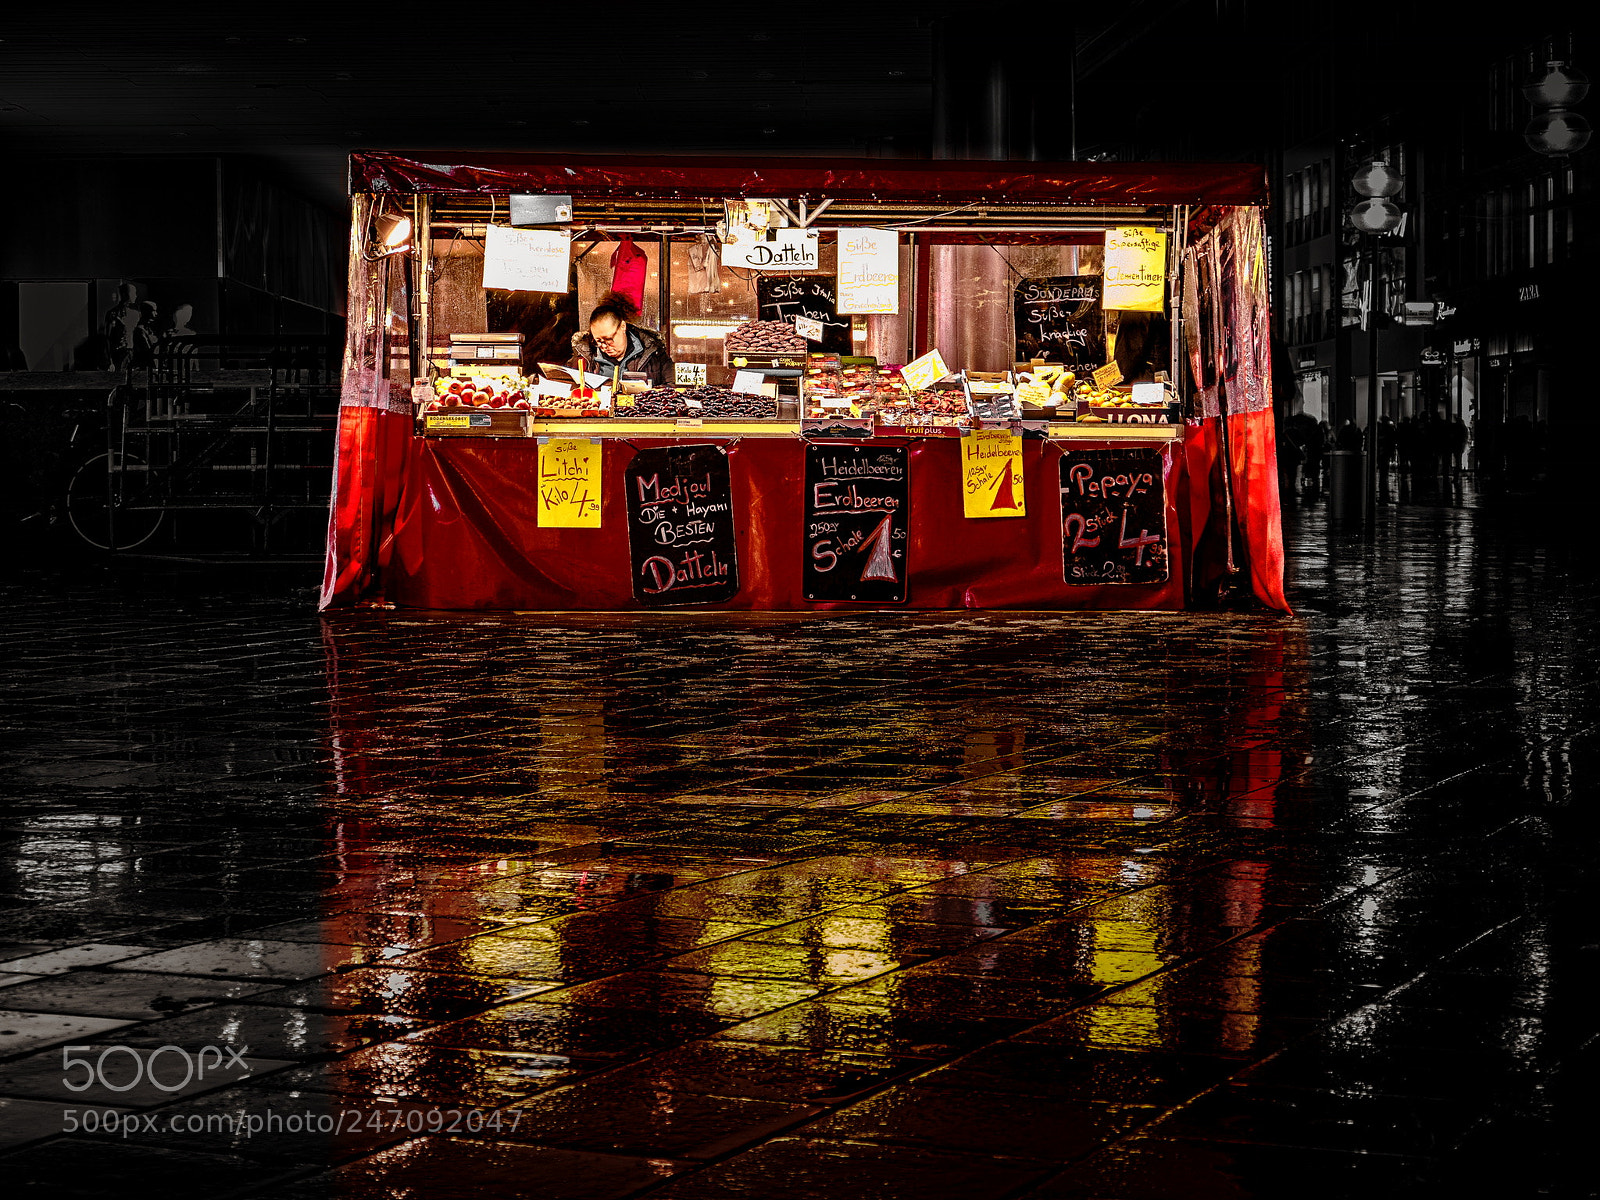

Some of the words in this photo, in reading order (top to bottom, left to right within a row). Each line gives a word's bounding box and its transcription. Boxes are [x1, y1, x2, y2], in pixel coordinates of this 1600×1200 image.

[746, 243, 815, 266] Datteln
[1105, 264, 1163, 282] Clementinen
[541, 455, 590, 478] Litchi
[821, 456, 903, 476] Heidelbeeren
[636, 473, 711, 505] Medjoul
[966, 472, 994, 494] Schale
[1069, 463, 1153, 499] Papaya
[541, 487, 569, 510] Kilo
[813, 482, 899, 509] Erdbeeren
[809, 521, 839, 539] 250gr
[1064, 512, 1101, 554] 2
[812, 530, 865, 573] Schale
[641, 550, 728, 594] Datteln
